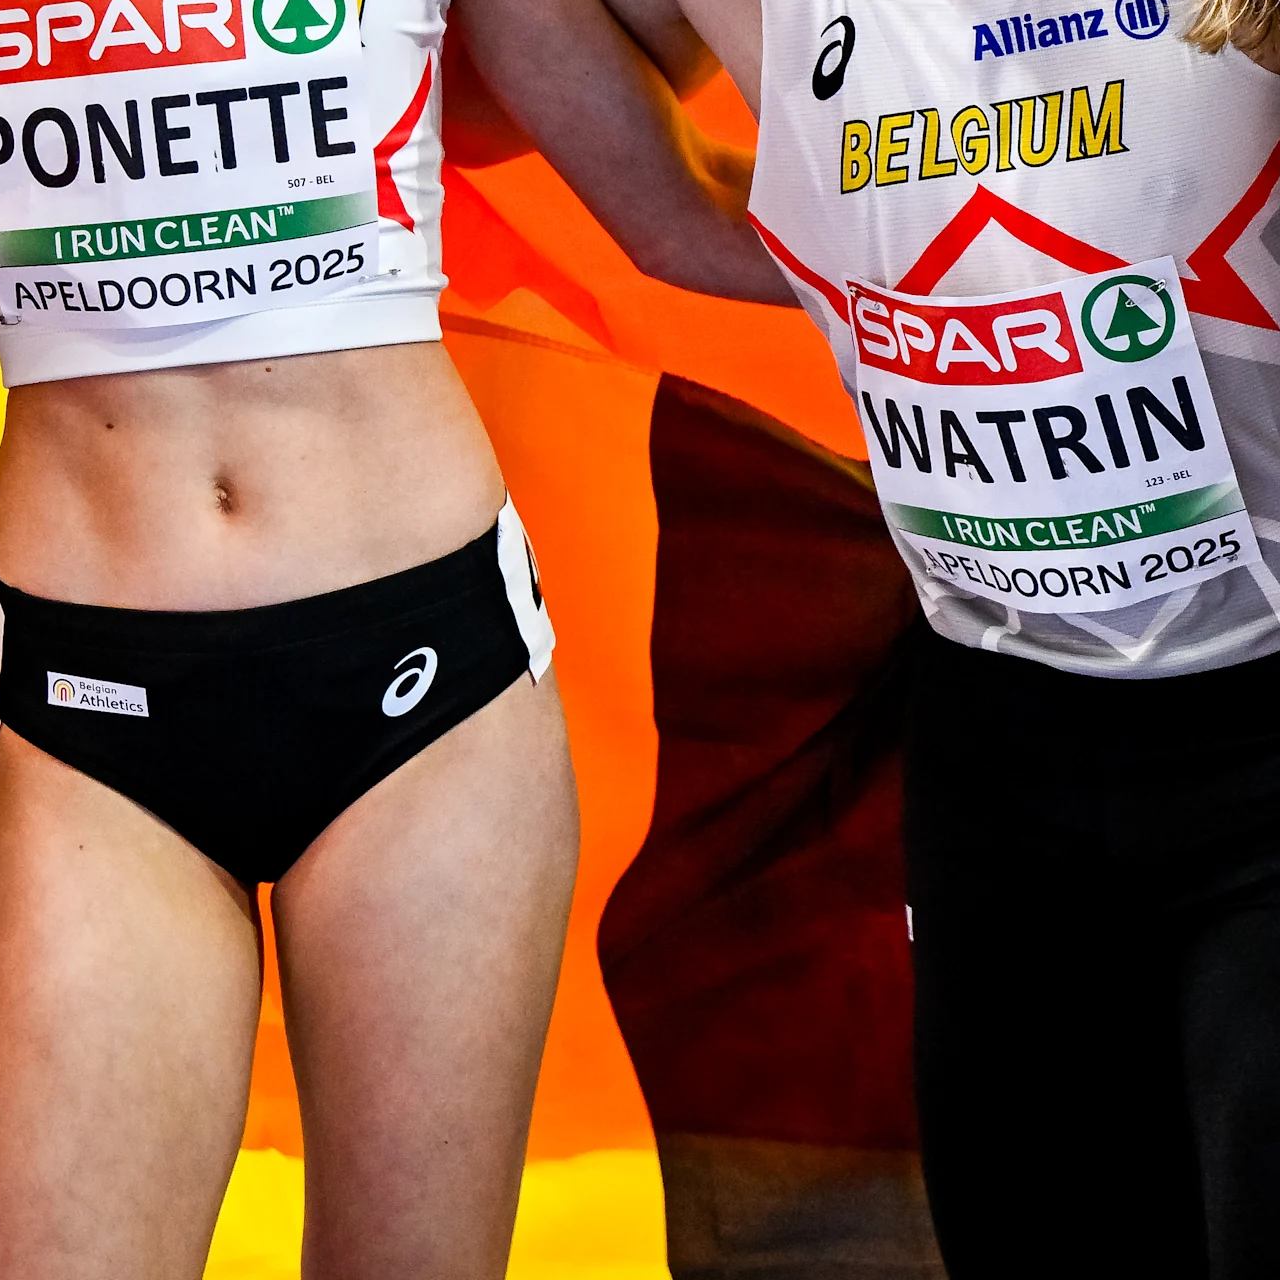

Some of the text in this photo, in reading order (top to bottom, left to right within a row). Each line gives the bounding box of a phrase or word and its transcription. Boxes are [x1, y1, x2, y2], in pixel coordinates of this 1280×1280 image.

[972, 8, 1109, 61] Allianz
[840, 78, 1130, 195] BELGIUM
[287, 178, 306, 189] 507
[316, 174, 335, 186] BEL
[54, 233, 63, 260] I
[72, 224, 146, 258] RUN
[15, 242, 365, 312] APELDOORN 2025
[856, 298, 1070, 374] SPAR
[861, 375, 1206, 484] WATRIN
[1145, 475, 1165, 488] 123
[1173, 470, 1192, 484] BEL
[942, 515, 954, 539] I
[958, 515, 1021, 547] RUN
[923, 529, 1241, 598] APELDOORN 2025
[79, 681, 117, 695] Belgian
[80, 693, 144, 713] Athletics
